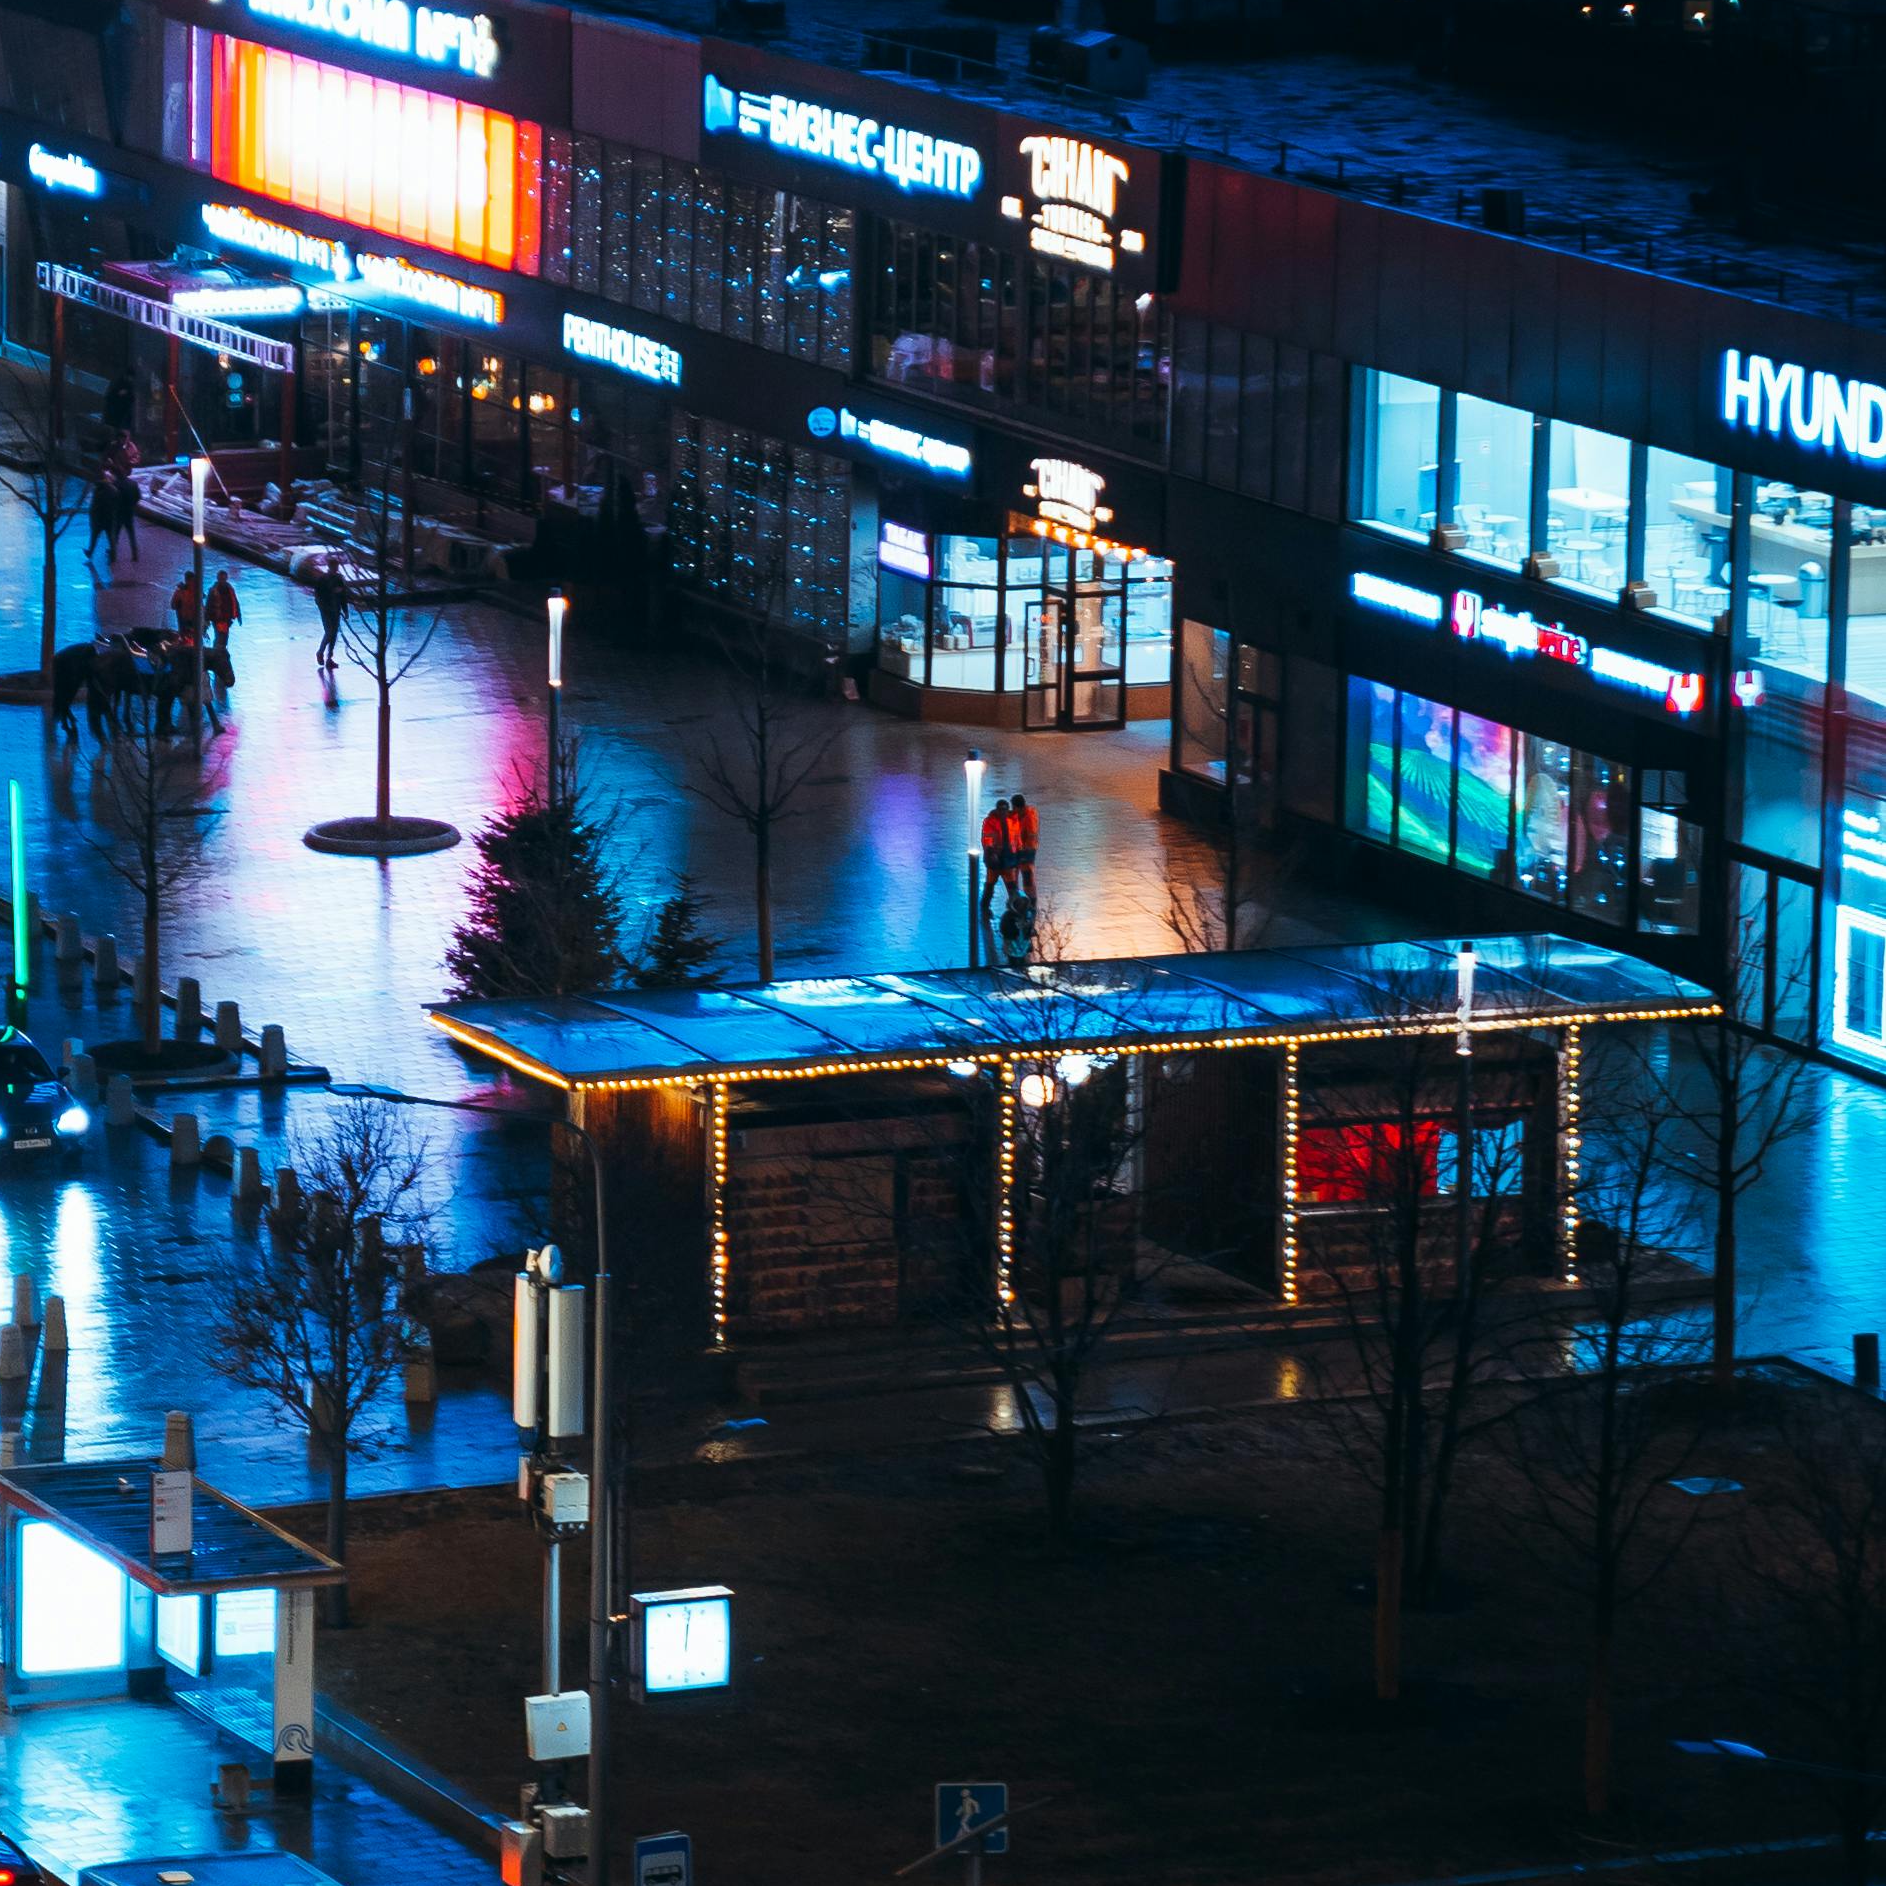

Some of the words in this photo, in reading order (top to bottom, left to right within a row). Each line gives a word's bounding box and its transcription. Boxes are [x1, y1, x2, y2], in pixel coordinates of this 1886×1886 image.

[769, 94, 981, 194] БИЗНЕС-ЦЕНТР
[563, 313, 661, 380] PENTHOUSE
[1724, 348, 1886, 459] HYUND
